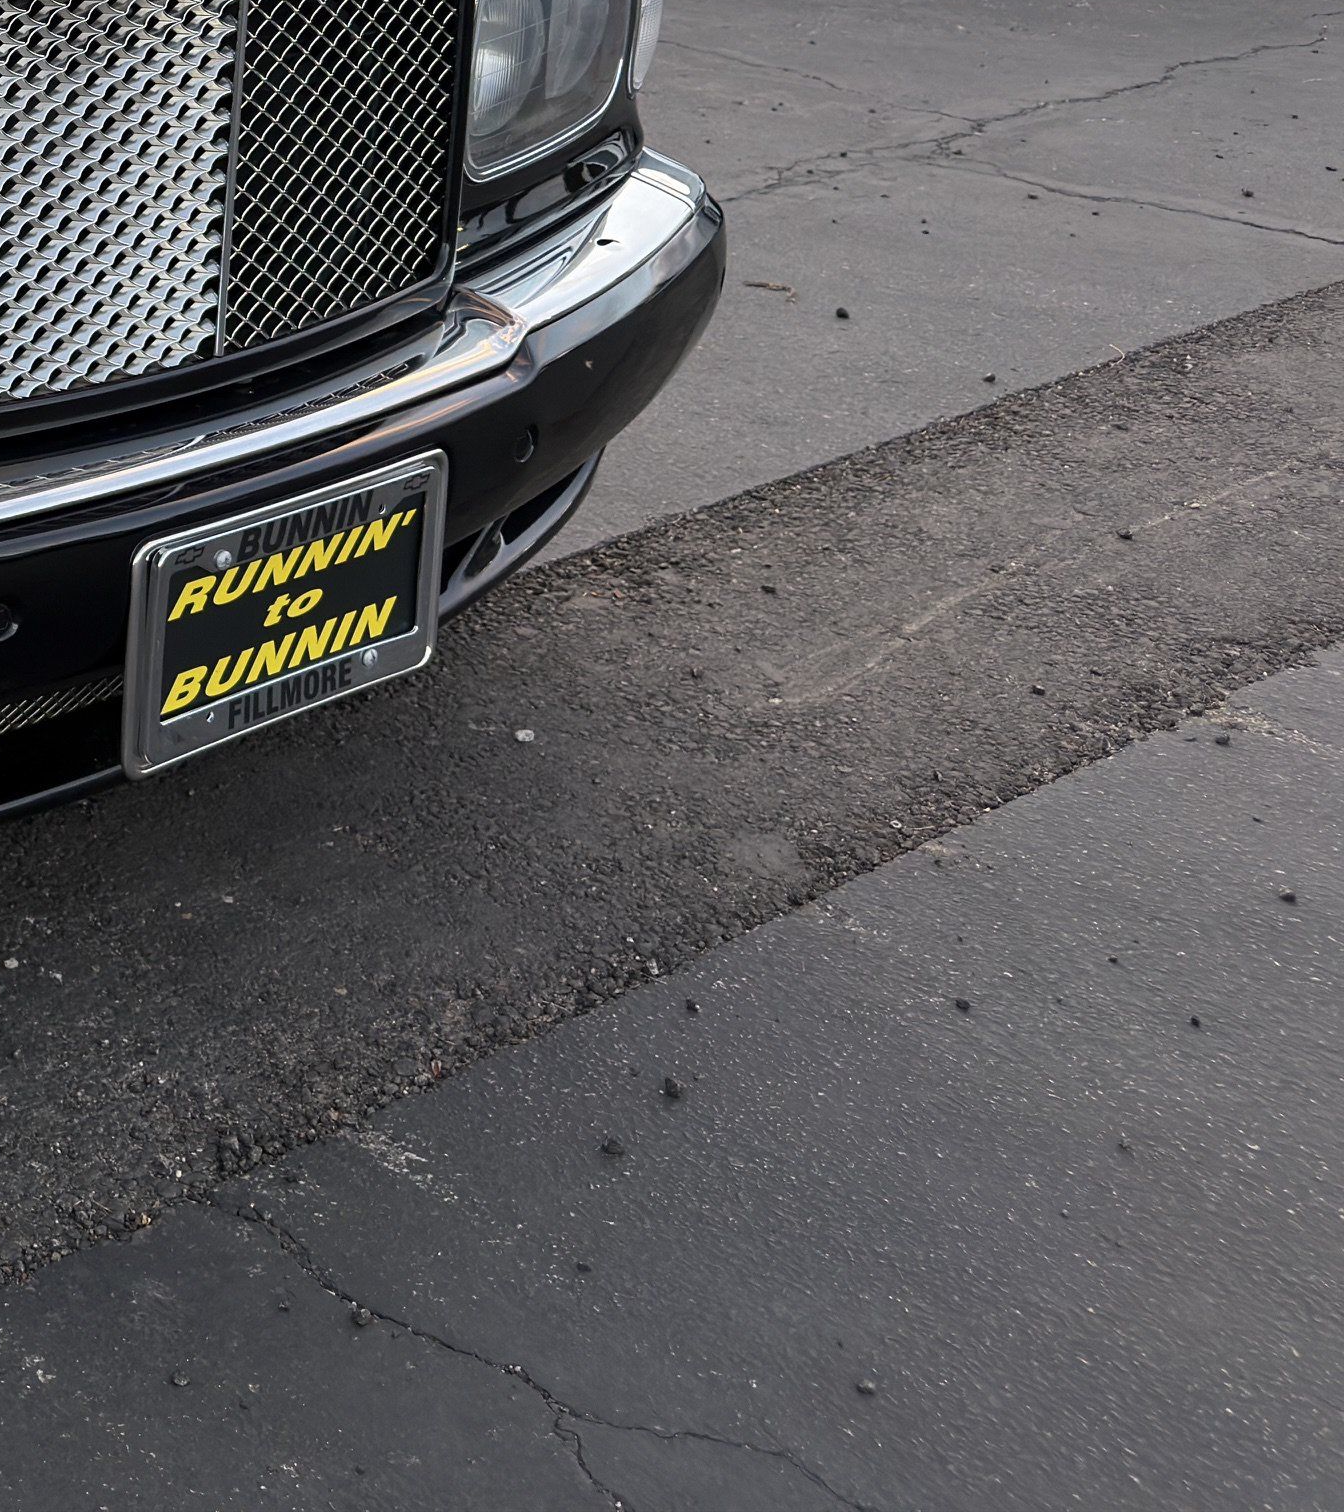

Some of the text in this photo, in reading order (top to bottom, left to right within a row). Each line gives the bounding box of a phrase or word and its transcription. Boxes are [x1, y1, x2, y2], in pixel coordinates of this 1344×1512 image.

[238, 492, 372, 560] BUNNIN
[168, 508, 417, 622] RUNNIN'
[263, 589, 323, 627] to
[160, 596, 397, 715] BUNNIN
[227, 657, 353, 730] FILLMORE
